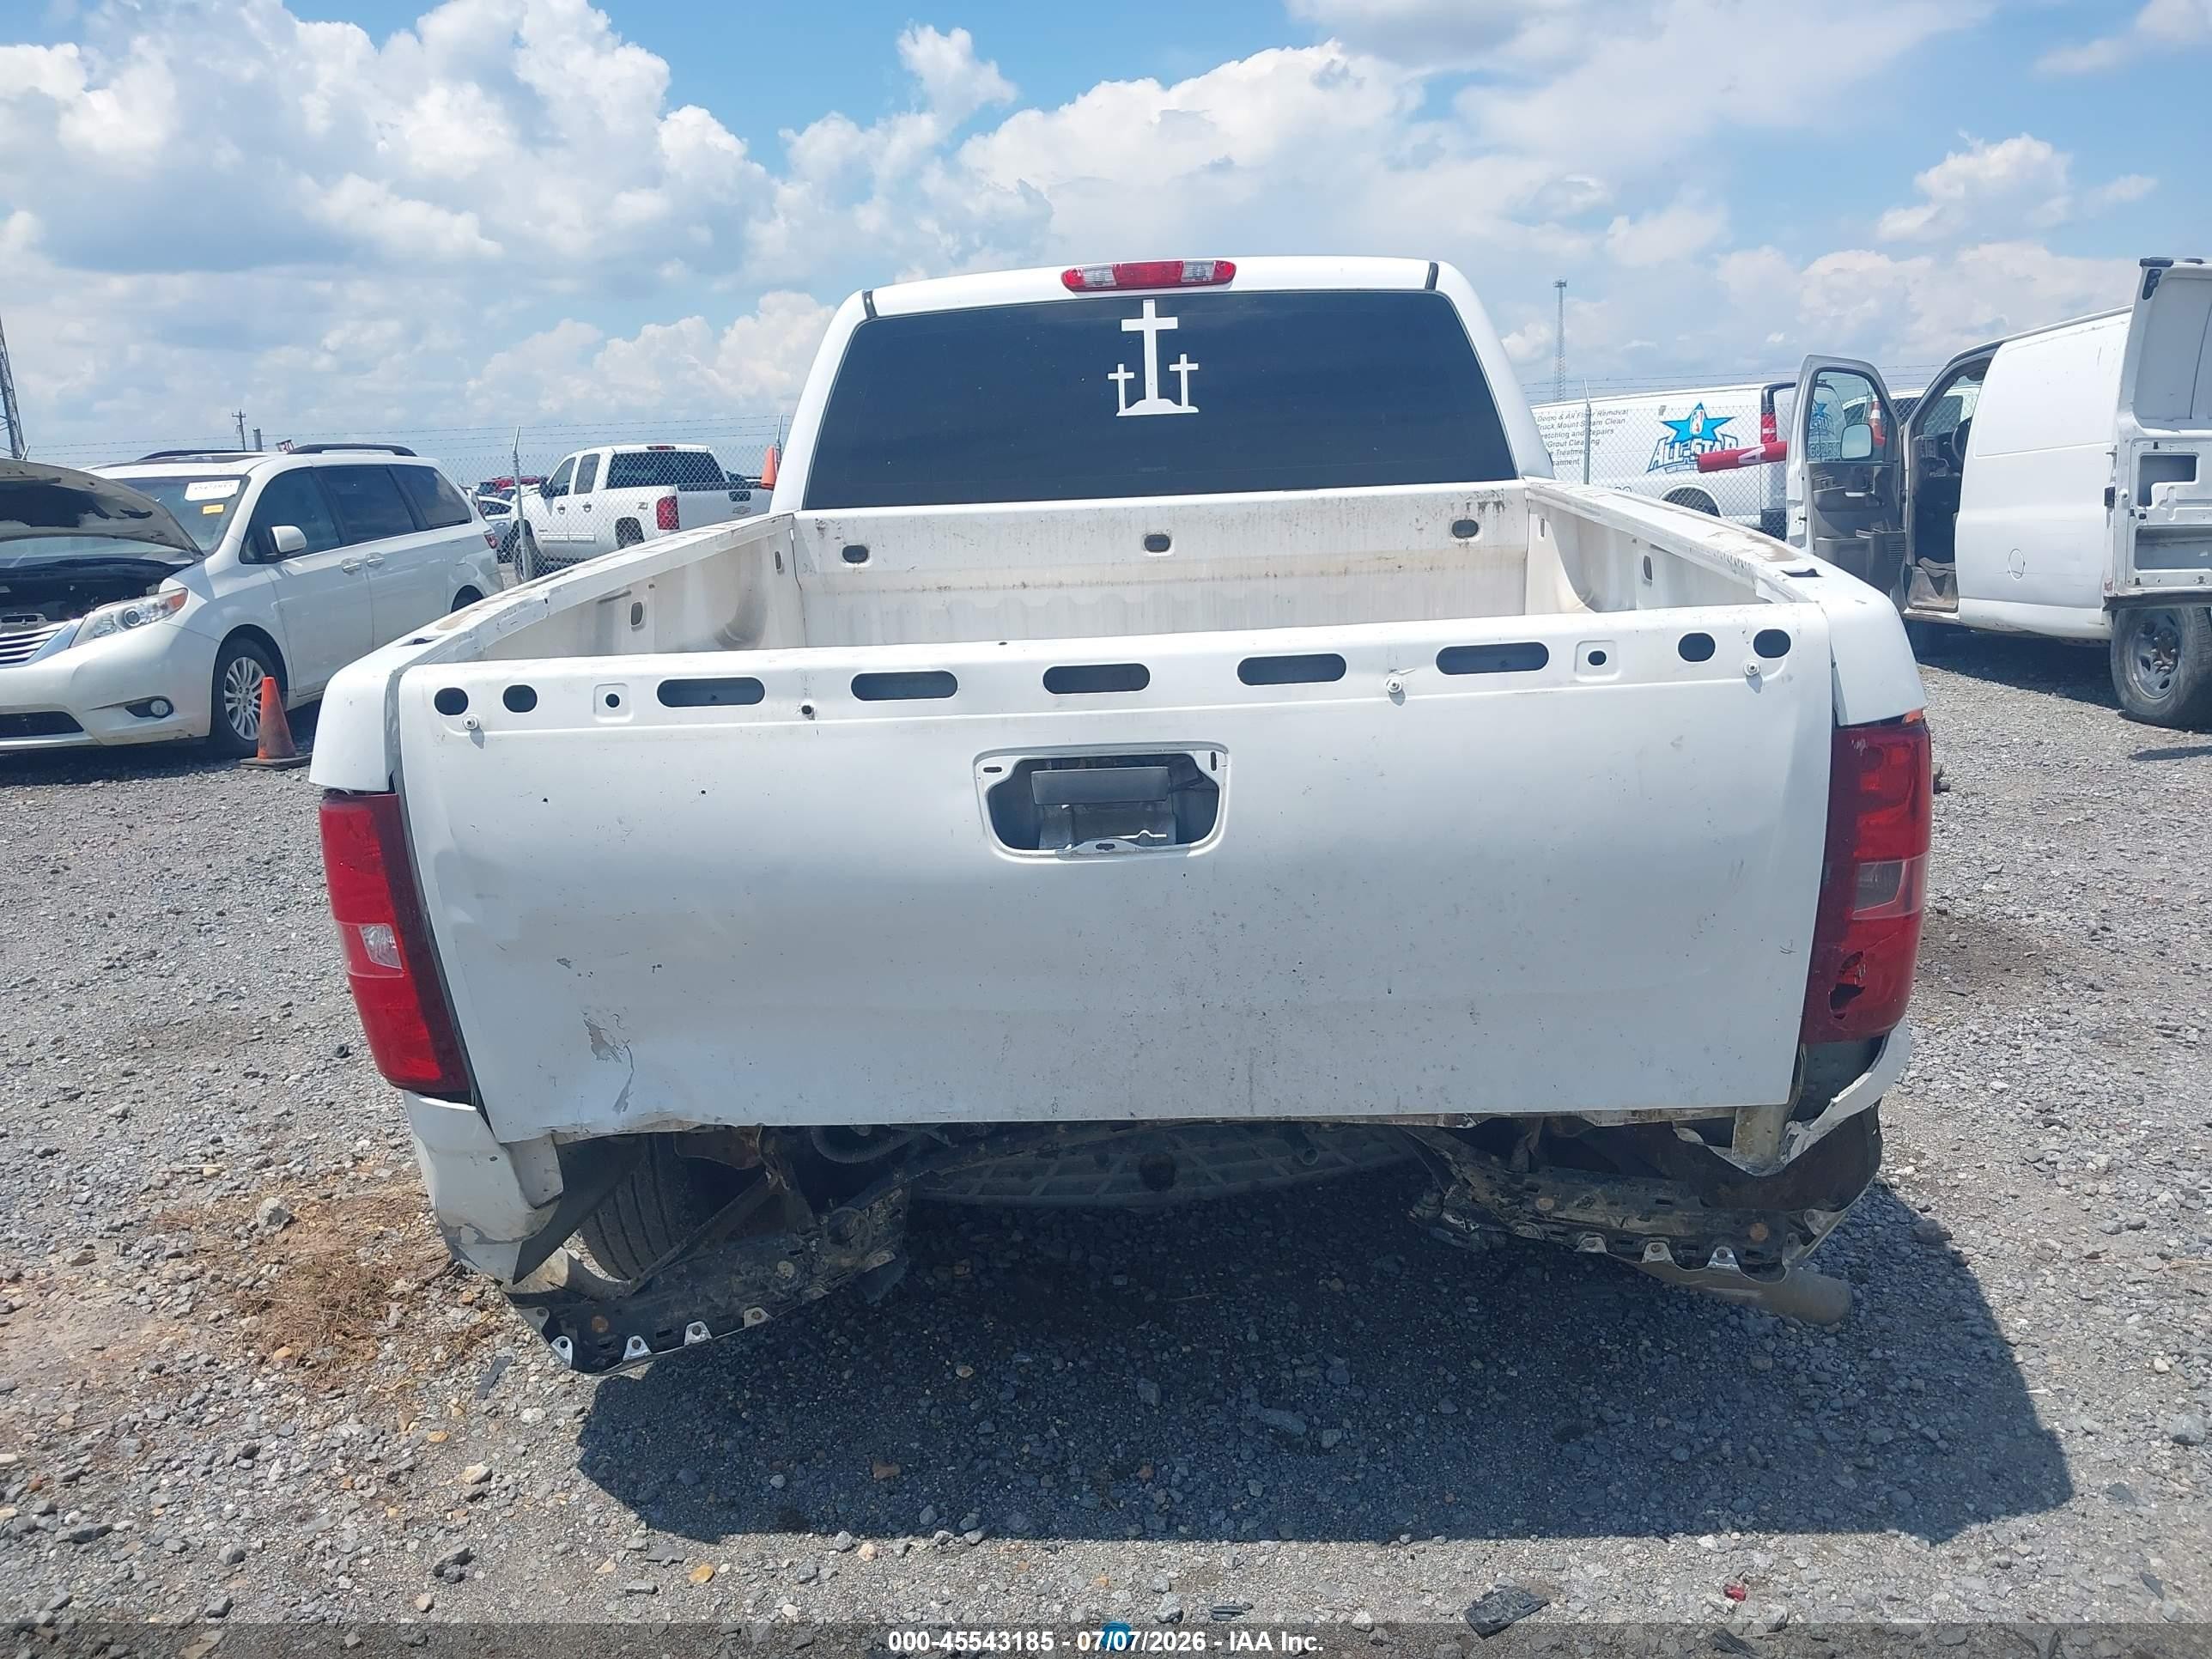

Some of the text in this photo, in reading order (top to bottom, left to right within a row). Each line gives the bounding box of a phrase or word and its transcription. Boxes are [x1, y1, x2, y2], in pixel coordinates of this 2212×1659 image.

[1596, 409, 1629, 417] Removal
[1557, 421, 1579, 429] Mount
[1591, 428, 1614, 438] epairs
